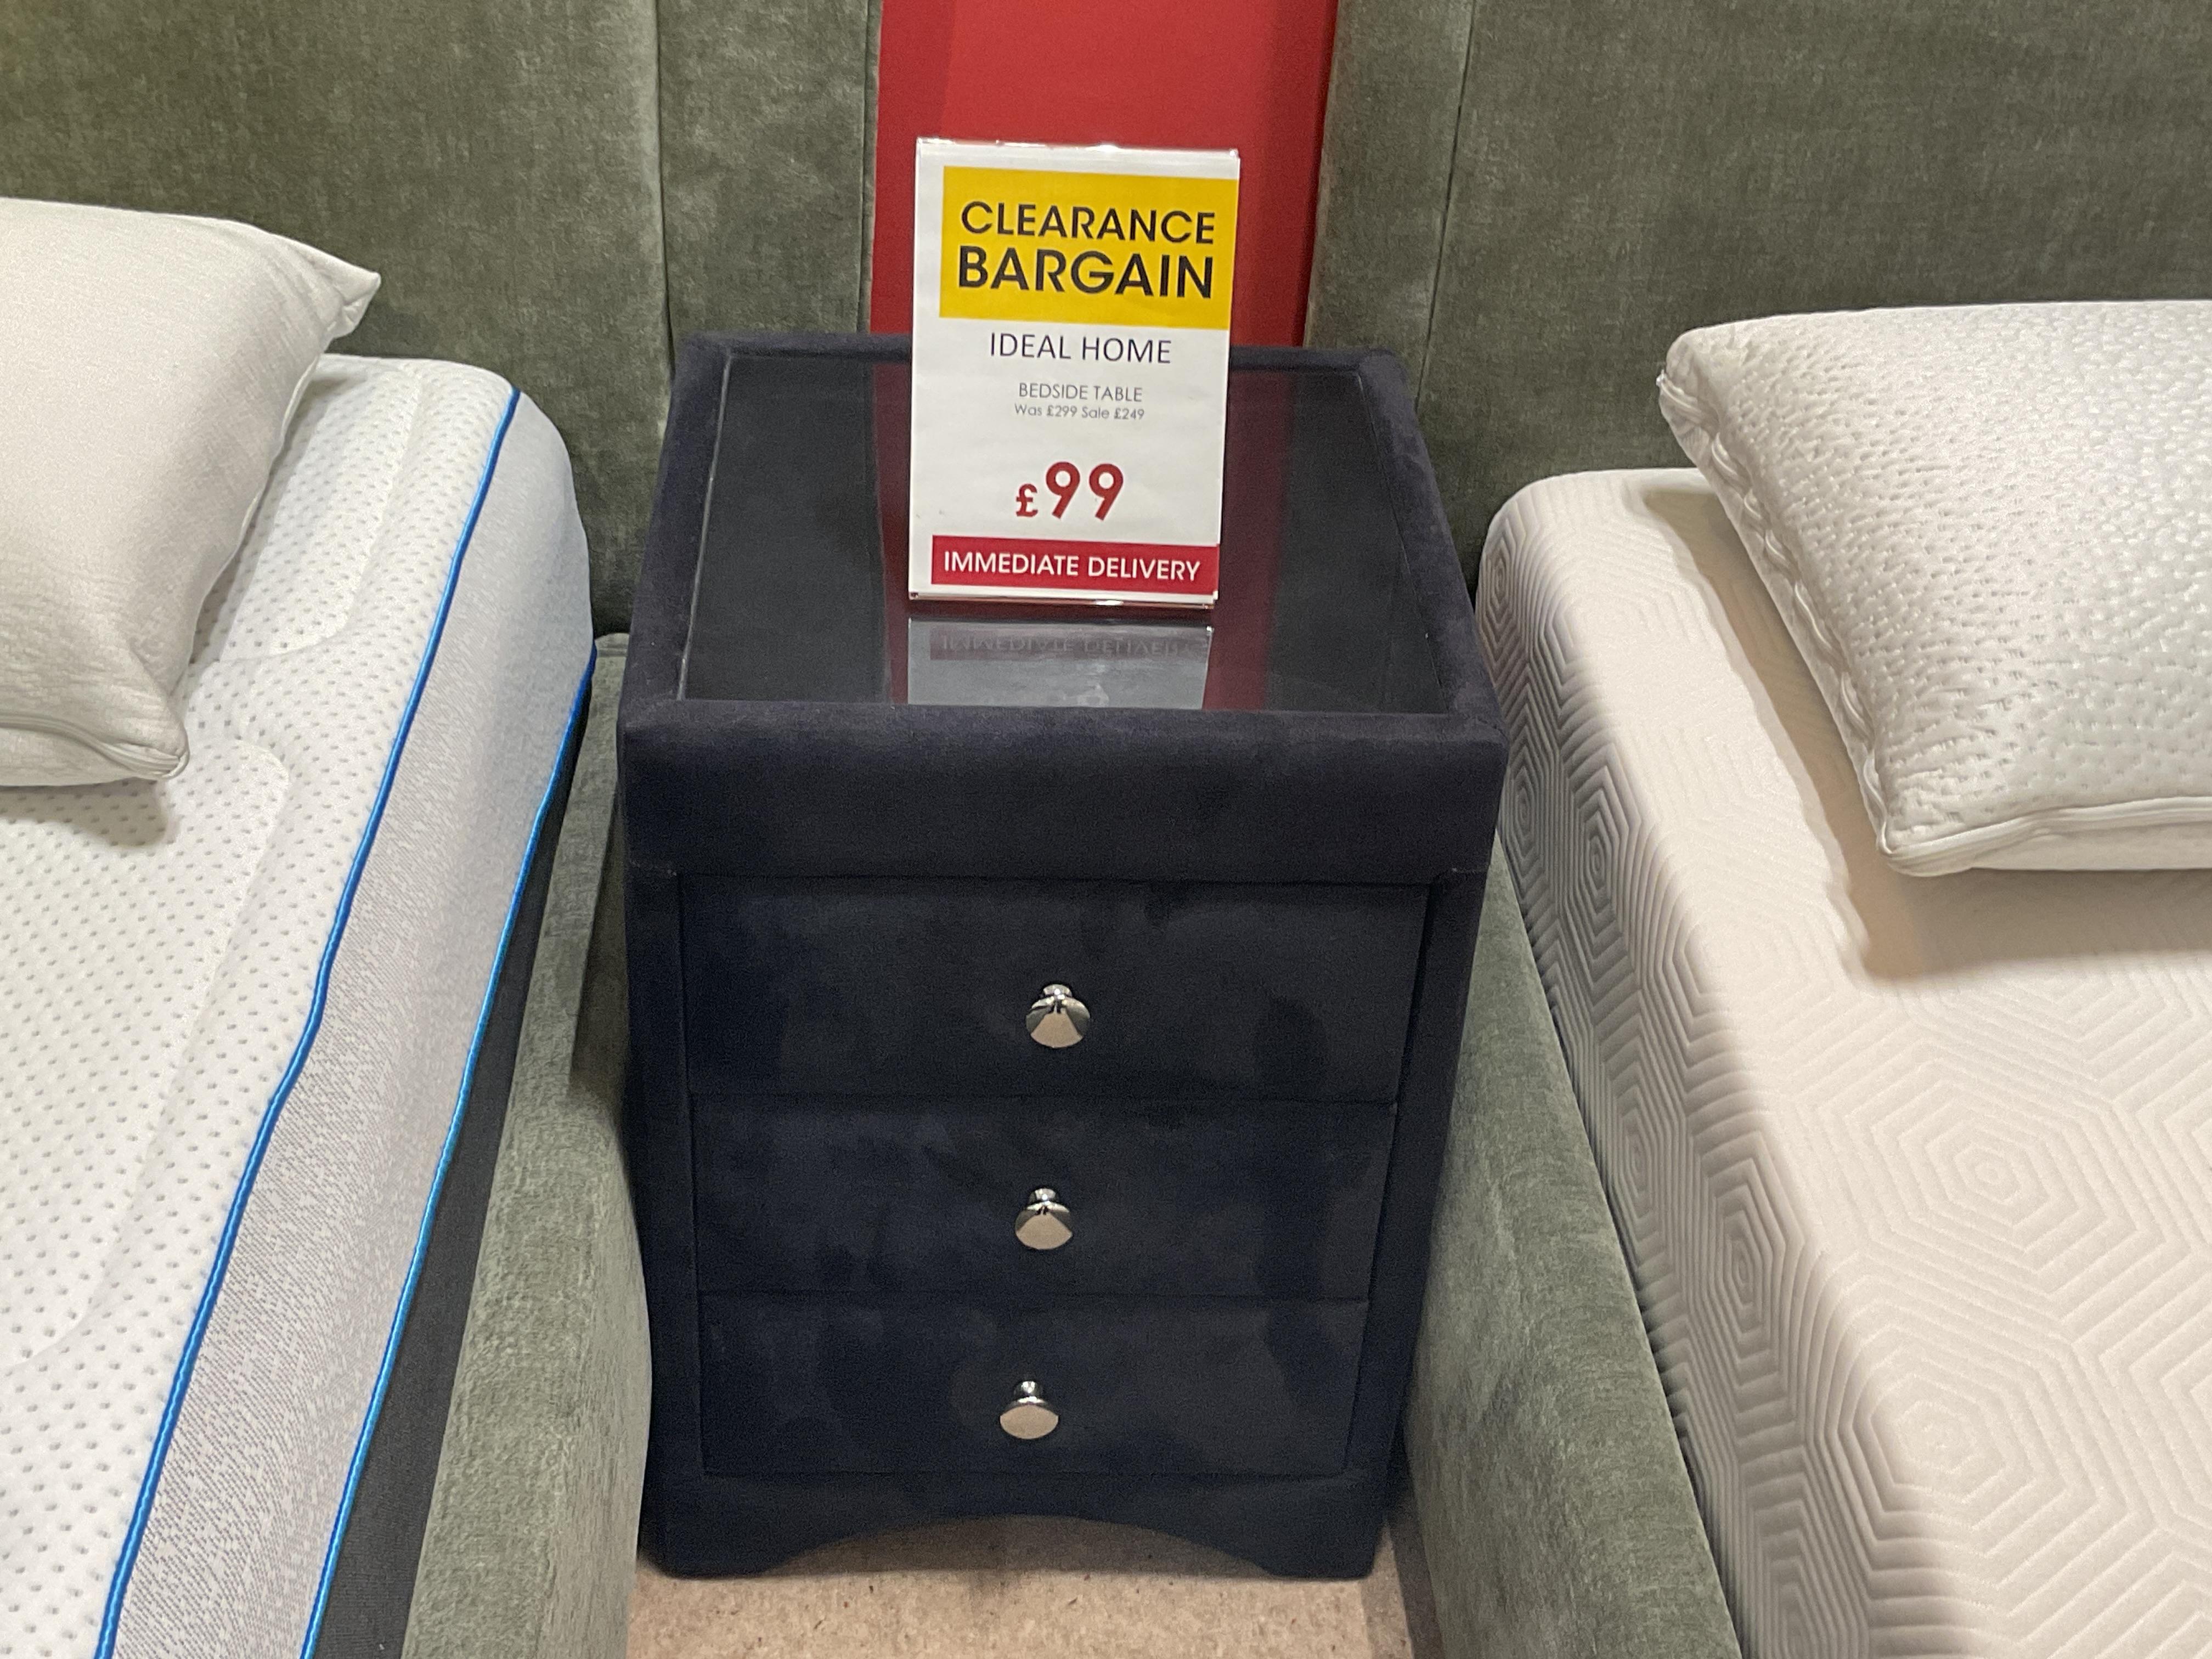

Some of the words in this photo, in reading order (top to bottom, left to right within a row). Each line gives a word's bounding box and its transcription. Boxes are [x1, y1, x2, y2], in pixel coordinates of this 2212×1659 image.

[961, 201, 1215, 245] CLEARANCE
[958, 245, 1214, 300] BARGAIN
[990, 332, 1071, 360] IDEAL
[1082, 336, 1172, 364] HOME
[1018, 382, 1088, 400] BEDSIDE
[1093, 385, 1142, 402] TABLE
[1014, 403, 1042, 416] Was
[1046, 404, 1078, 417] £299
[1081, 406, 1110, 419] Sale
[1114, 408, 1145, 420] £249
[1015, 461, 1124, 521] £99
[944, 550, 1080, 576] IMMEDIATE
[1087, 556, 1201, 582] DELIVERY
